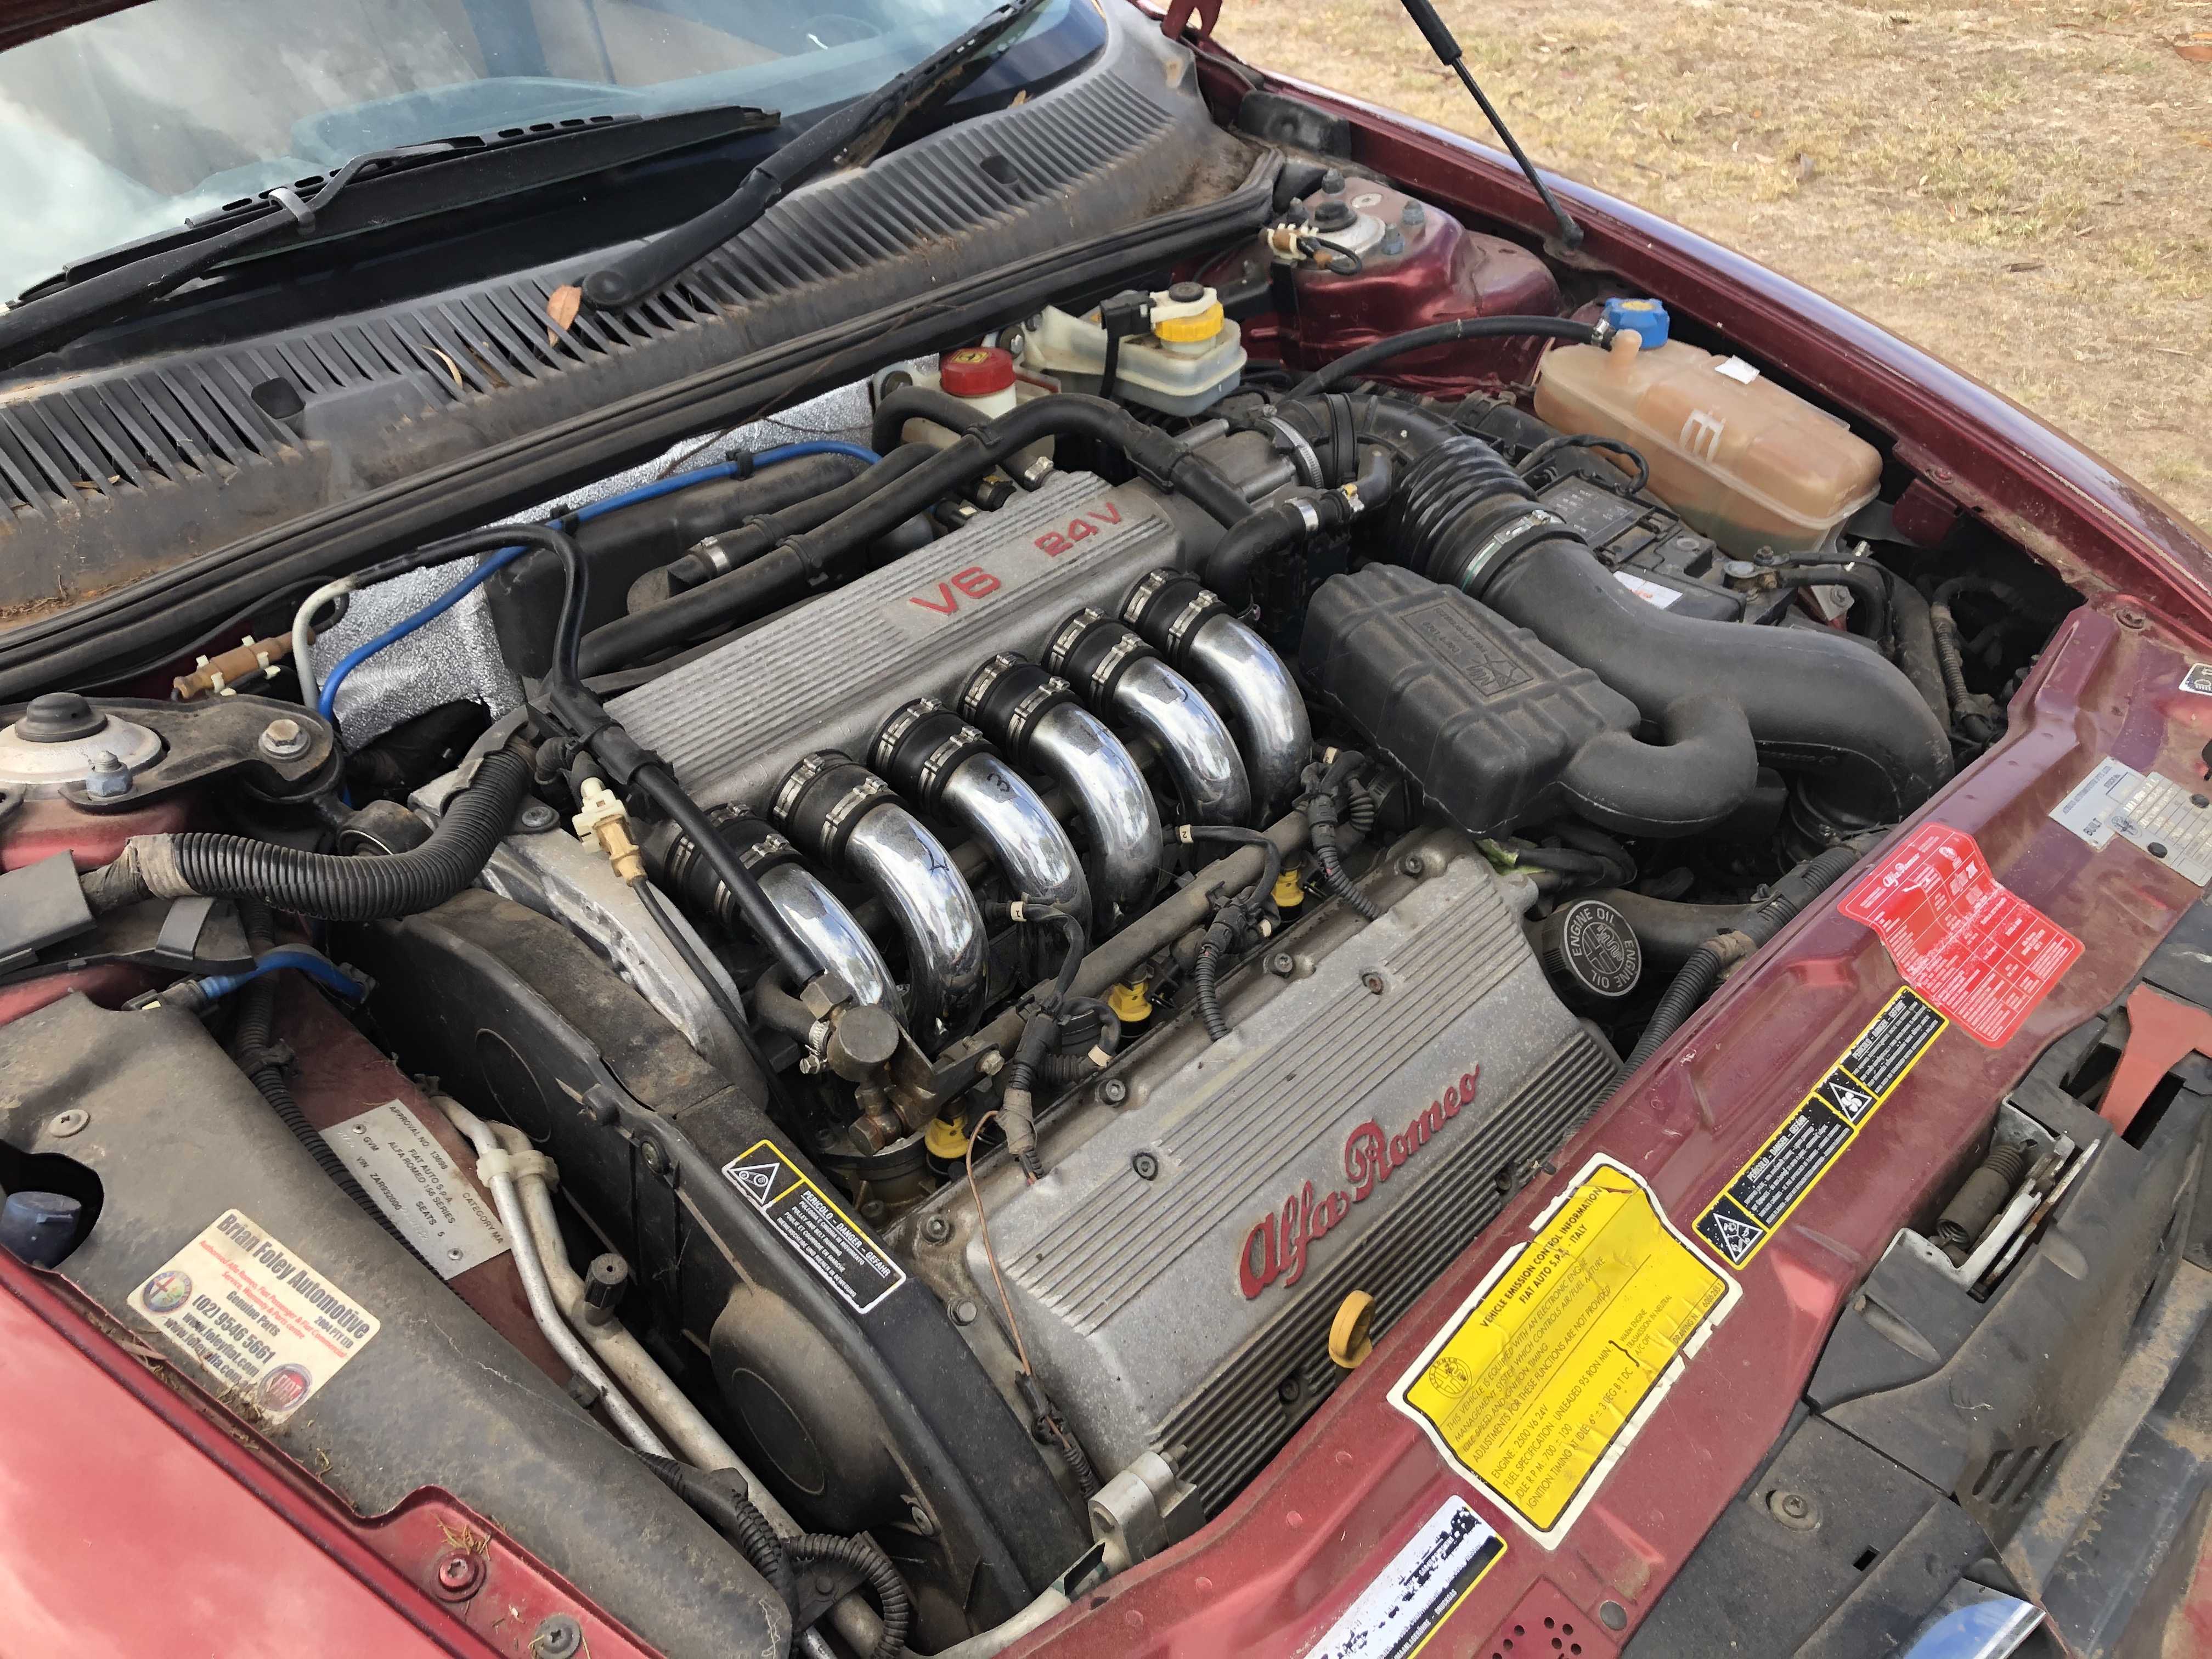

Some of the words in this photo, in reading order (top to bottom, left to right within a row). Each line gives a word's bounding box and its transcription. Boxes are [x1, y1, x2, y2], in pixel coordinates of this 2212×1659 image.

[909, 566, 1002, 615] V6
[1034, 503, 1122, 557] 24V
[1570, 907, 1593, 957] ENGINE
[1596, 907, 1615, 927] OIL
[1591, 969, 1610, 989] OIL
[1615, 939, 1636, 989] ENGINE
[355, 1156, 370, 1169] VIN
[387, 1141, 407, 1159] ALFA
[1768, 1135, 1789, 1156] DANGER
[362, 1136, 380, 1152] GVM
[413, 1200, 439, 1226] SEATS
[388, 1104, 420, 1137] APPROVAL
[459, 1192, 498, 1231] CATEGORY
[490, 1231, 505, 1244] MA
[400, 1157, 427, 1184] ROMEO
[407, 1148, 425, 1164] FIAT
[419, 1163, 441, 1184] AUTO
[1239, 1180, 1350, 1299] Alfa
[1345, 1064, 1480, 1204] Romeo
[422, 1183, 437, 1197] 156
[429, 1196, 458, 1224] SERIES
[783, 1211, 800, 1227] POULIE
[821, 1248, 830, 1257] EN
[826, 1254, 846, 1273] MARCHE
[790, 1205, 808, 1222] PULLEY
[804, 1219, 817, 1231] AND
[812, 1227, 826, 1239] BELT
[822, 1237, 843, 1257] RUNNING
[802, 1189, 834, 1220] PERICOLO
[835, 1222, 864, 1249] DANGER
[864, 1250, 892, 1277] GEFAHR
[804, 1245, 817, 1257] UND
[839, 1240, 866, 1266] MOVIMENTO
[1479, 1297, 1508, 1330] VEHICLE
[1503, 1263, 1537, 1301] EMISSION
[1532, 1231, 1564, 1267] CONTROL
[1559, 1185, 1603, 1236] INFORMATION
[1517, 1284, 1536, 1305] FIAT
[1531, 1264, 1553, 1289] AUTO
[1568, 1222, 1588, 1245] ITALY
[215, 1212, 264, 1252] Brian
[249, 1240, 300, 1282] Foley
[285, 1267, 375, 1340] Automotive
[197, 1239, 231, 1265] Authorised
[225, 1261, 241, 1274] Alfa
[257, 1285, 272, 1298] Fiat
[266, 1294, 298, 1321] Passenger
[299, 1319, 314, 1332] Fiat
[309, 1328, 348, 1359] Commercial
[224, 1289, 263, 1321] Genuine
[255, 1314, 283, 1338] Parts
[240, 1286, 270, 1311] Warranty
[266, 1306, 275, 1314] &
[1649, 1311, 1657, 1320] IN
[1654, 1292, 1673, 1315] NEUTRAL
[190, 1293, 223, 1320] (02)
[212, 1311, 250, 1342] 9546
[239, 1333, 277, 1365] 5661
[270, 1310, 289, 1325] Parts
[285, 1322, 306, 1339] centre
[313, 1315, 334, 1333] 2004
[328, 1327, 345, 1342] PTY
[339, 1335, 355, 1349] LTD
[1618, 1324, 1634, 1344] WARM
[1630, 1307, 1647, 1329] ENGINE
[1672, 1317, 1695, 1345] DRAWING
[1690, 1310, 1701, 1321] N.
[179, 1311, 263, 1378] www.foleyfiat.com
[1445, 1412, 1463, 1431] THIS
[1458, 1384, 1486, 1415] VEHICLE
[1481, 1378, 1491, 1389] IS
[1511, 1328, 1530, 1349] WITH
[1525, 1316, 1539, 1331] AN
[1535, 1279, 1571, 1321] ELECTRONIC
[1452, 1387, 1499, 1443] MANAGEMENT
[1512, 1340, 1536, 1367] WHICH
[1531, 1306, 1563, 1344] CONTROLS
[1558, 1278, 1585, 1311] AIR/FUEL
[1633, 1342, 1645, 1356] A/C
[1641, 1333, 1652, 1346] OFF
[267, 1373, 302, 1405] FIAT
[1469, 1412, 1513, 1463] ADJUSTMENTS
[1506, 1397, 1523, 1416] FOR
[1516, 1377, 1539, 1402] THESE
[1532, 1340, 1567, 1381] FUNCTIONS
[1561, 1328, 1577, 1345] ARE
[1572, 1313, 1589, 1332] NOT
[1584, 1283, 1613, 1318] PROVIDED
[1612, 1381, 1622, 1391] B
[1616, 1376, 1626, 1386] T
[1620, 1365, 1633, 1380] DC
[1460, 1434, 1477, 1453] IDLE
[1472, 1412, 1494, 1438] SPEED
[1489, 1396, 1507, 1417] AND
[1501, 1364, 1532, 1400] IGNITION
[1526, 1340, 1551, 1369] TIMING.
[1598, 1401, 1607, 1411] 3
[1602, 1386, 1618, 1405] DEG
[1502, 1468, 1520, 1489] FUEL
[1551, 1383, 1584, 1422] UNLEADED
[1577, 1374, 1590, 1388] 95
[1585, 1359, 1602, 1379] RON
[1596, 1344, 1614, 1363] MIN.
[1513, 1427, 1532, 1449] 2500
[1526, 1417, 1540, 1432] V6
[1534, 1402, 1550, 1421] 24V
[1574, 1423, 1591, 1442] IDLE
[1549, 1447, 1574, 1477] TIMING
[1568, 1438, 1579, 1451] AT
[1514, 1480, 1531, 1499] IDLE
[1525, 1474, 1535, 1484] R
[1530, 1468, 1539, 1478] P
[1541, 1442, 1558, 1462] 700
[1525, 1472, 1556, 1510] IGNITION
[1432, 1588, 1459, 1615] DRUCKGAS
